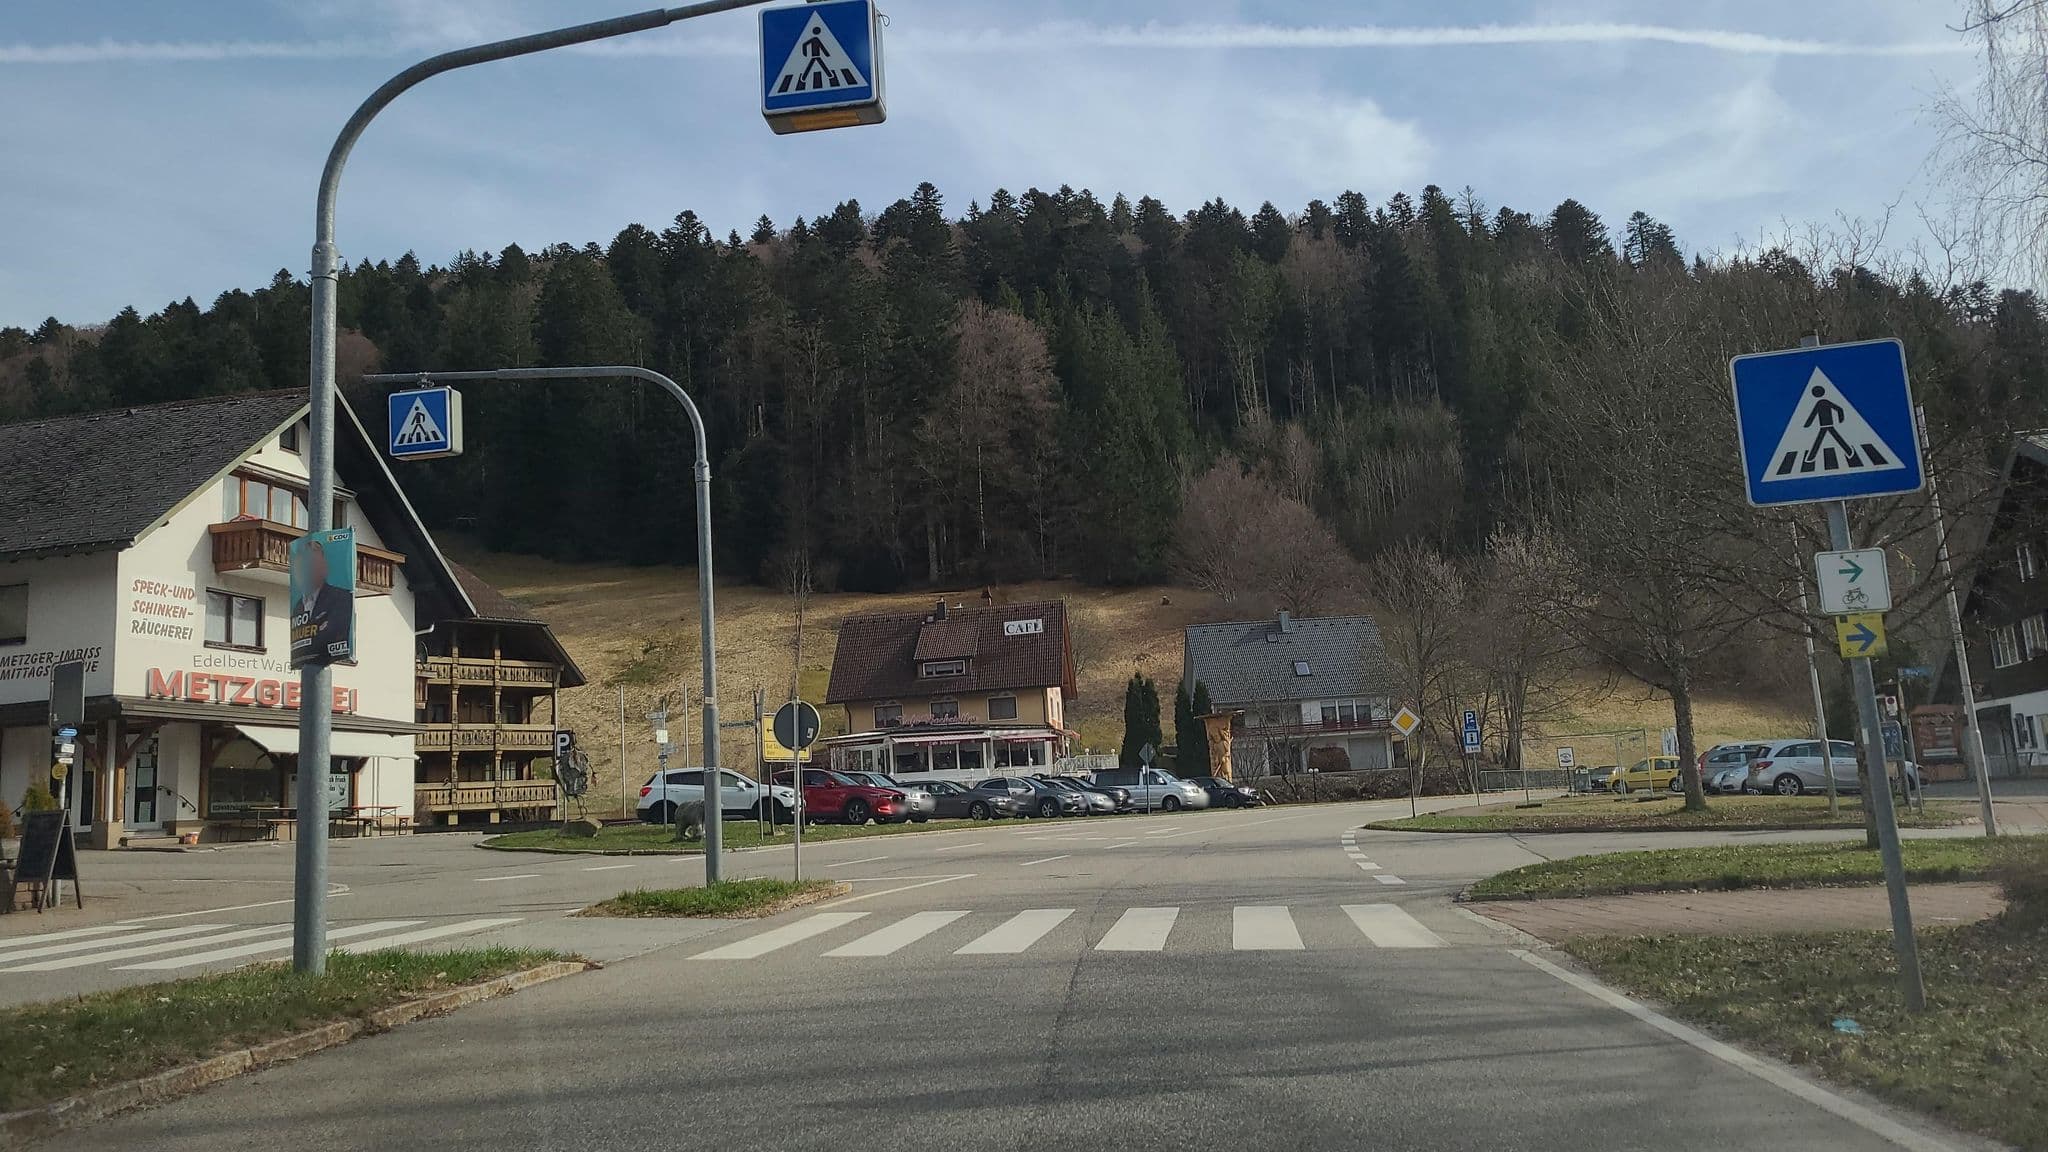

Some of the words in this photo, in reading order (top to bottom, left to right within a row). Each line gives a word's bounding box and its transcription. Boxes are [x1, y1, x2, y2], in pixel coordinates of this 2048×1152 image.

[133, 579, 195, 600] SPECK-UND
[132, 600, 194, 619] SCHINKEN-
[131, 618, 193, 640] RÄUCHEREI
[0, 647, 101, 668] METZGER-IMBISS
[193, 655, 259, 670] Edelbert
[148, 667, 358, 714] METZGEEI
[556, 733, 570, 757] P
